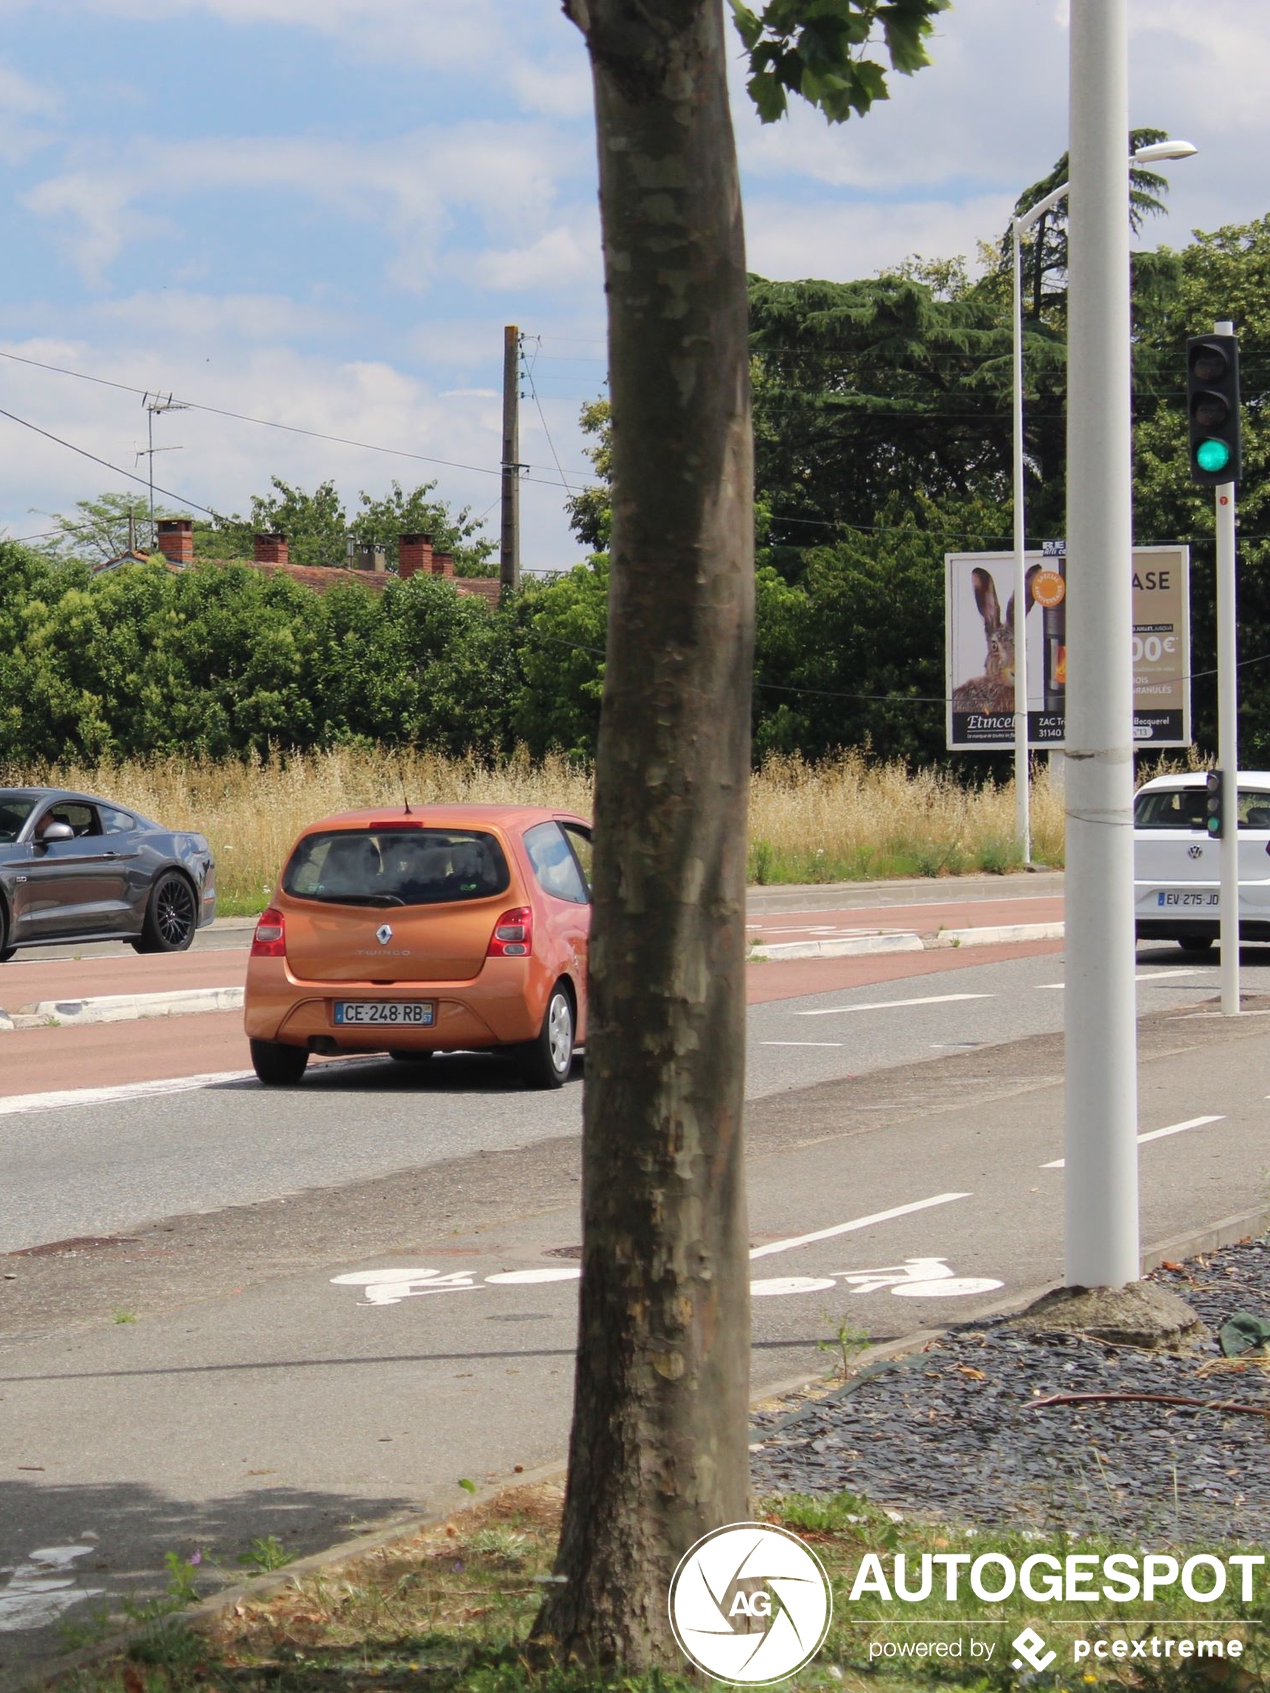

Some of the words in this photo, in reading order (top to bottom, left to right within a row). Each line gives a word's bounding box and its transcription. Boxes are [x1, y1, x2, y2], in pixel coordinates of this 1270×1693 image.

[1042, 540, 1065, 550] RE
[1132, 571, 1171, 590] ASE
[967, 715, 1015, 729] Etincel
[1039, 717, 1056, 726] ZAC
[1134, 716, 1170, 728] Becquerel
[1039, 729, 1062, 738] 31140
